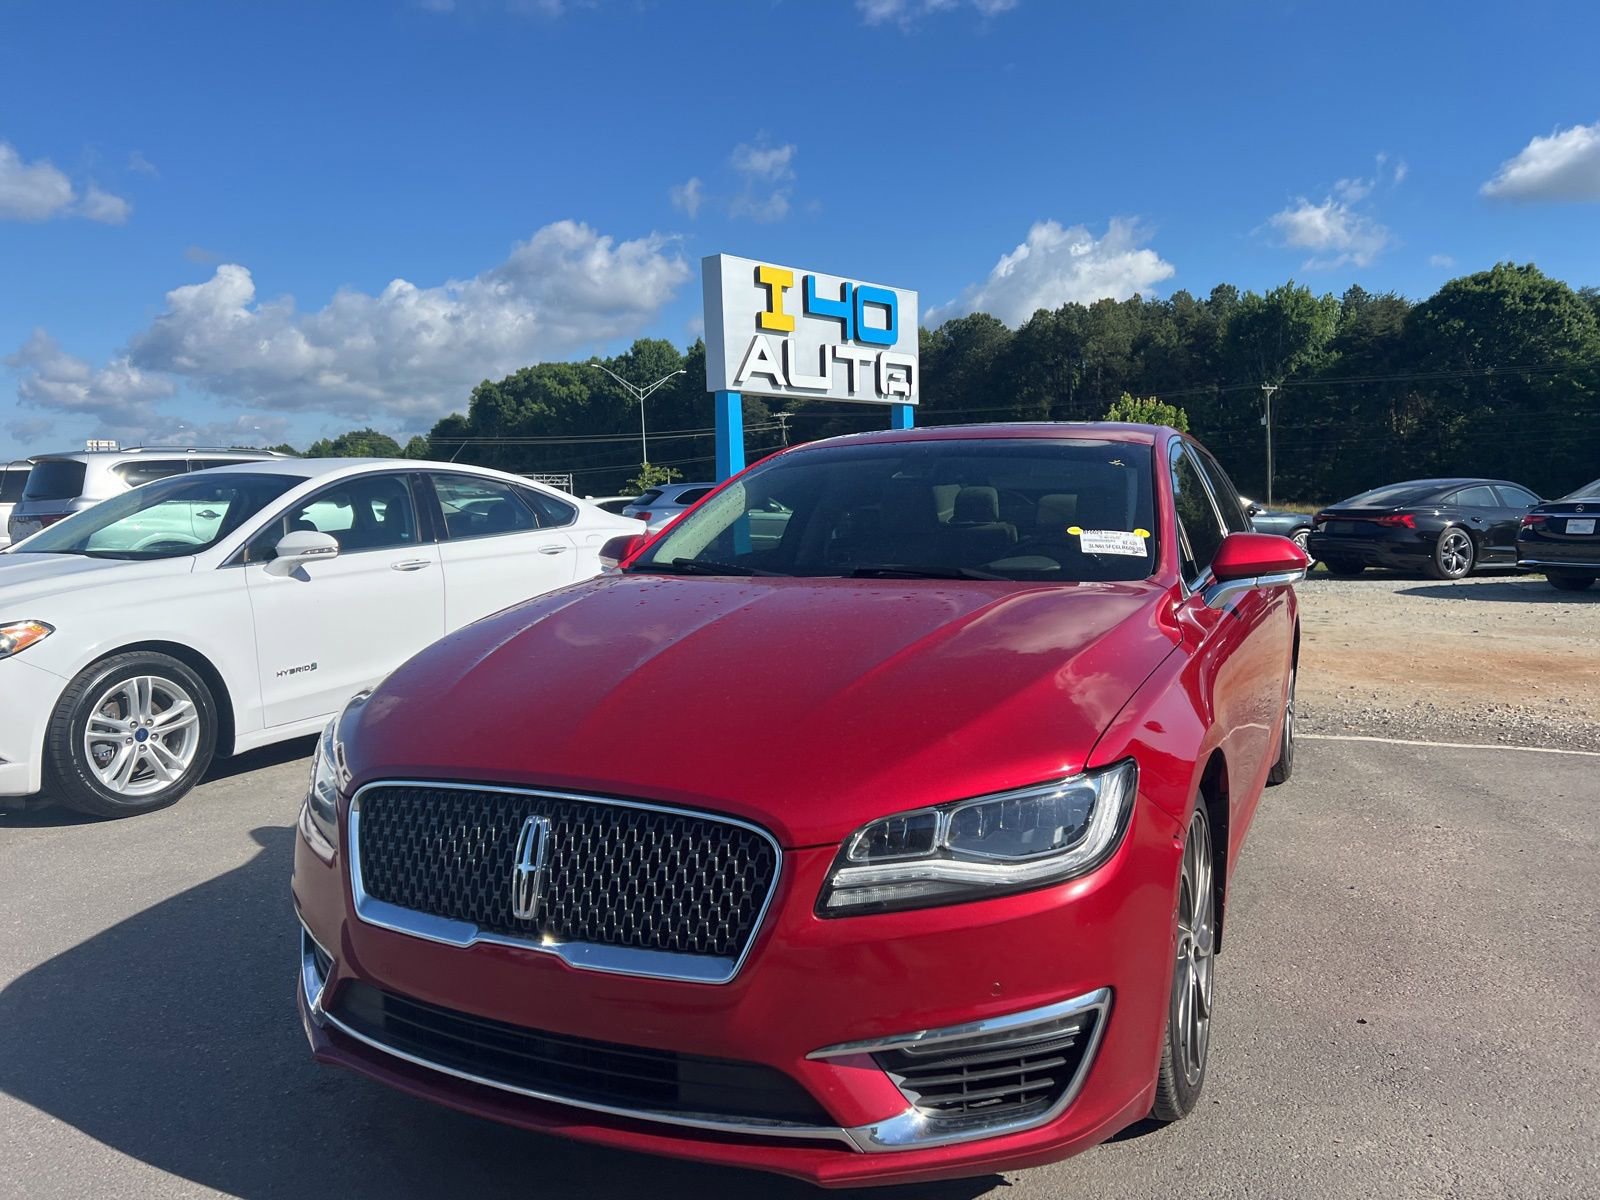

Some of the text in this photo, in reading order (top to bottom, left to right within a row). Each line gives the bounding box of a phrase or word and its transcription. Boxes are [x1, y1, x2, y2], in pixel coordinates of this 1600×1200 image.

[755, 264, 898, 345] I 40
[734, 334, 917, 396] AUTO
[276, 665, 310, 677] HYBRID
